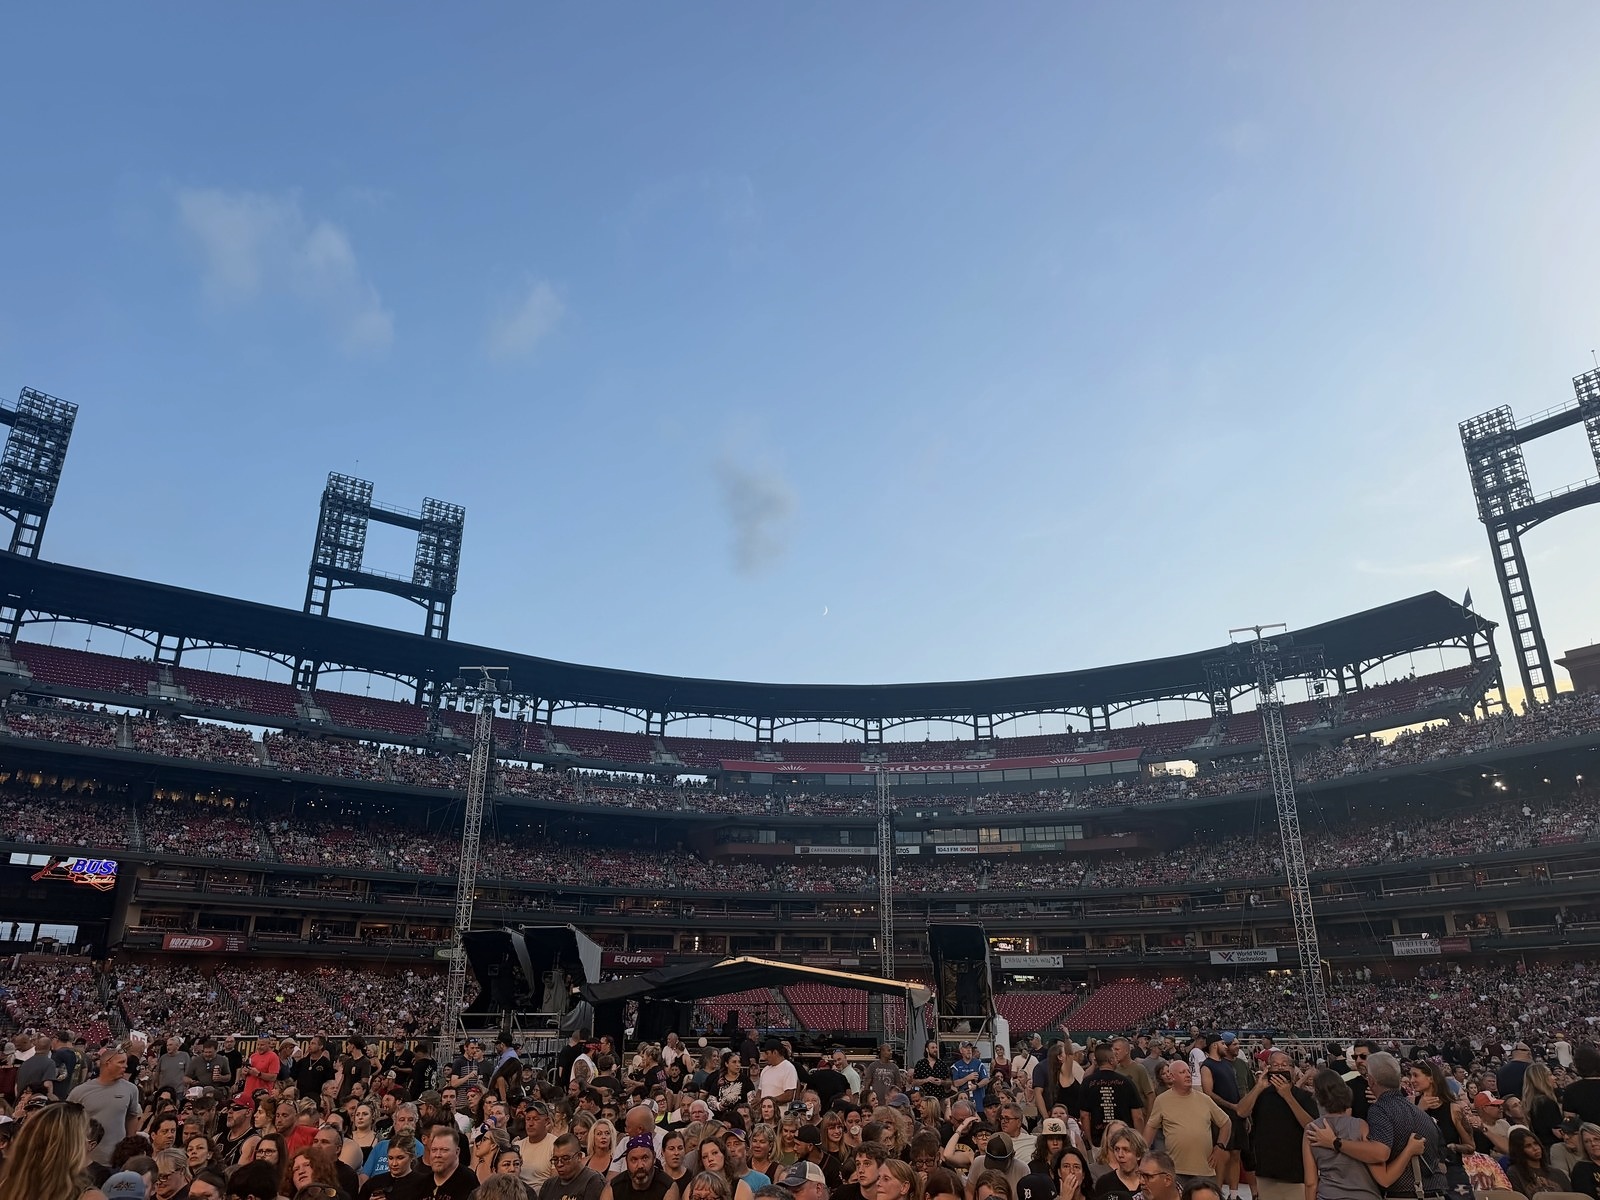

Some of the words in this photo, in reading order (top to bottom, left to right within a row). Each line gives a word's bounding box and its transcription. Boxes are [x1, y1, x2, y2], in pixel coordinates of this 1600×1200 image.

[862, 762, 991, 773] Budweiser
[170, 938, 207, 946] HOFFMANN
[613, 955, 653, 964] EQUIFAX
